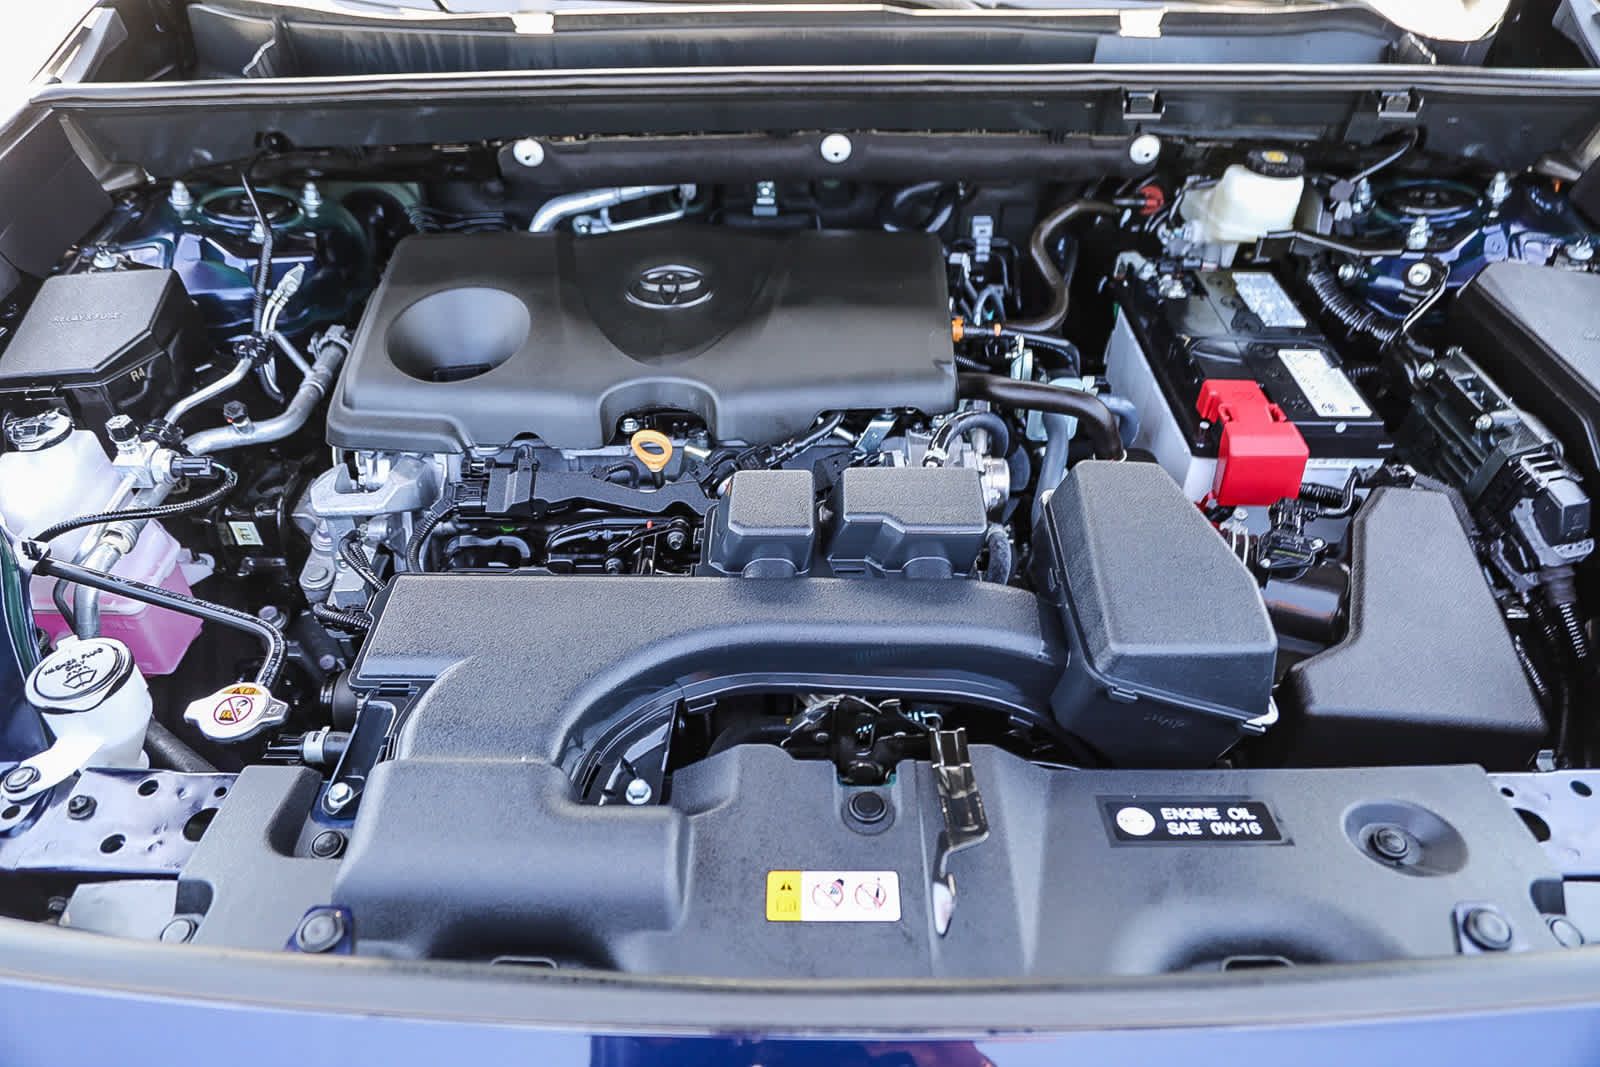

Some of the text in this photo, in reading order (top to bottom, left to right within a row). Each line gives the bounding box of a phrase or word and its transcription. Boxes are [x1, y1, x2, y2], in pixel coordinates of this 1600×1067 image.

[130, 368, 145, 382] R4
[1160, 807, 1257, 820] ENGINE OIL
[1166, 822, 1263, 835] SAE 0W-16
